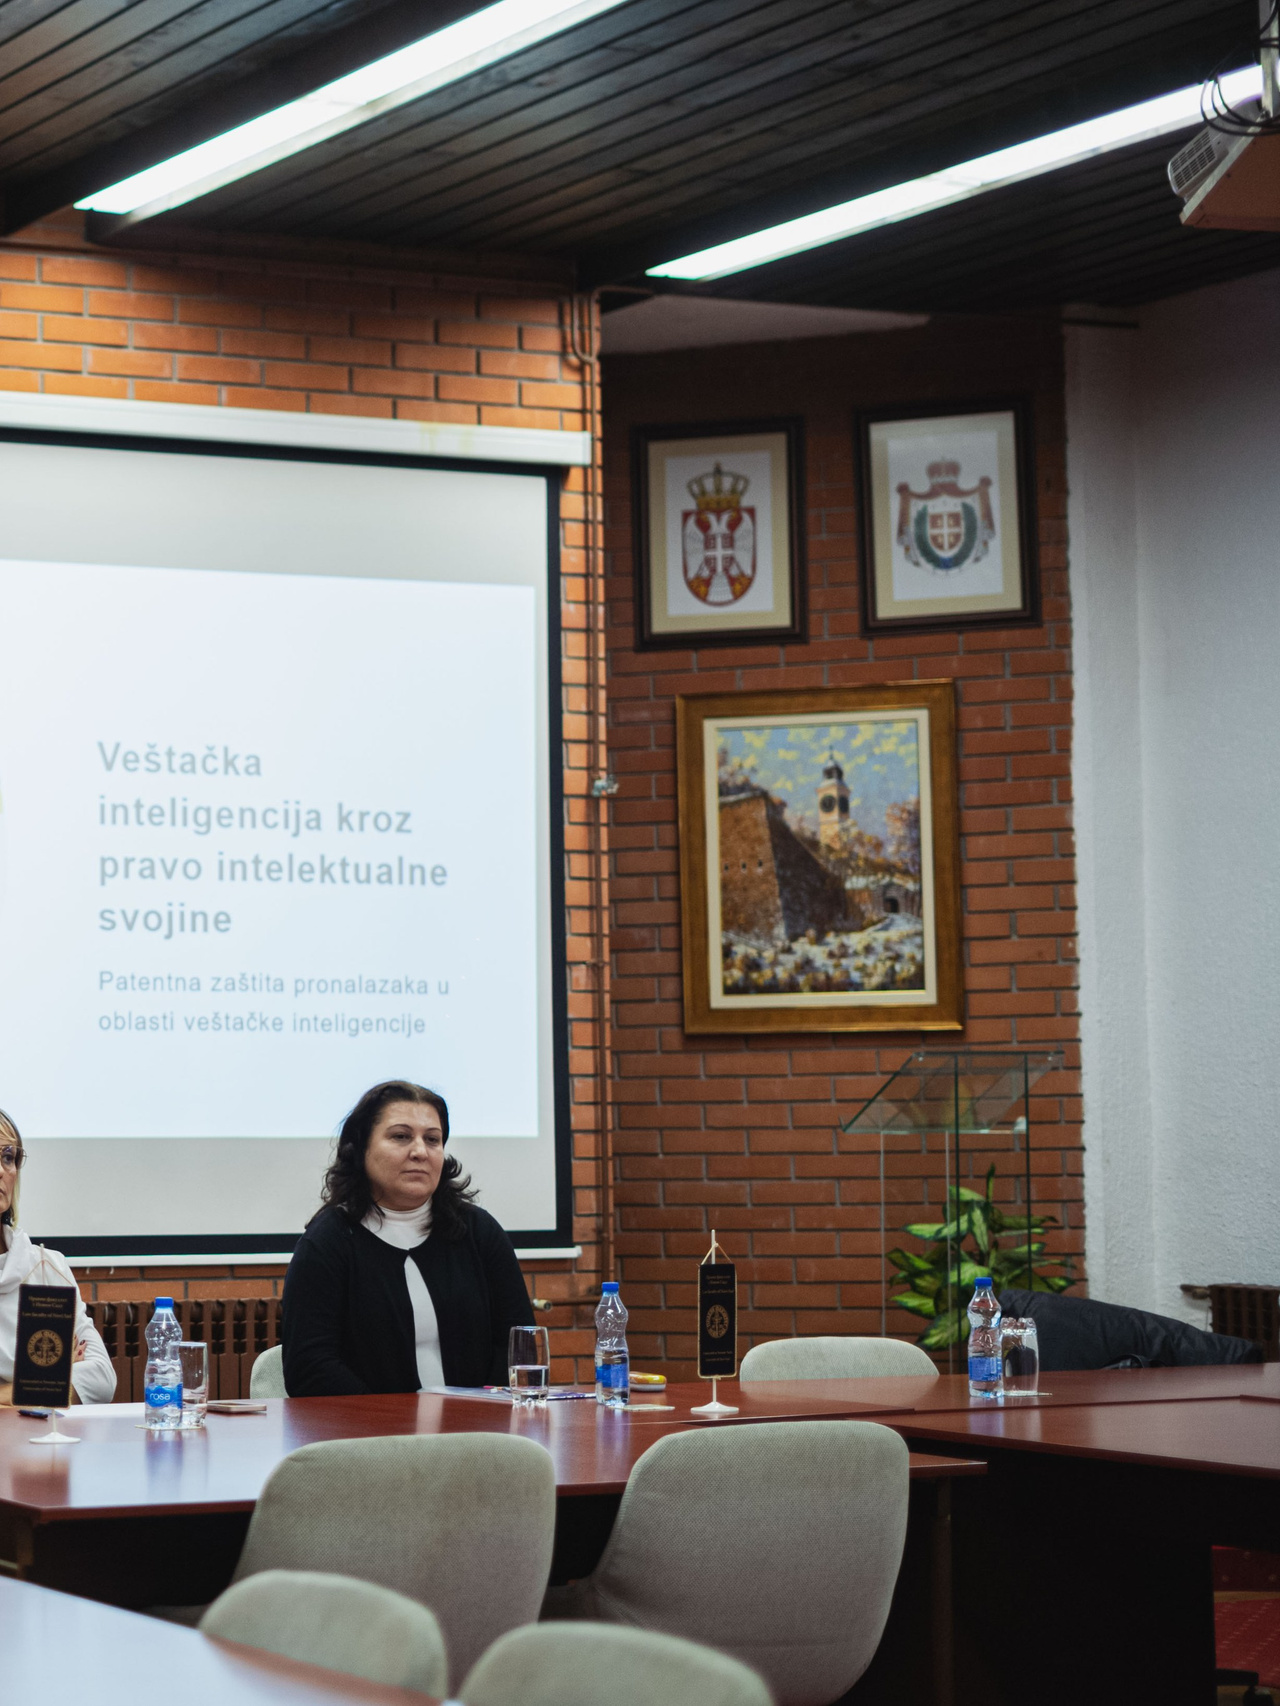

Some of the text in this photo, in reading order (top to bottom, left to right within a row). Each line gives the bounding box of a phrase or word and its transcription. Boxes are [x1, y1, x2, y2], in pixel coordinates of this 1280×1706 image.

[97, 741, 262, 777] Veštačka
[99, 795, 413, 838] inteligencija kroz
[99, 851, 448, 886] pravo intelektualne
[99, 902, 232, 940] svojine
[98, 971, 450, 998] Patentna zaštita pronalazaka u
[98, 1011, 426, 1038] oblasti veštačke inteligencije
